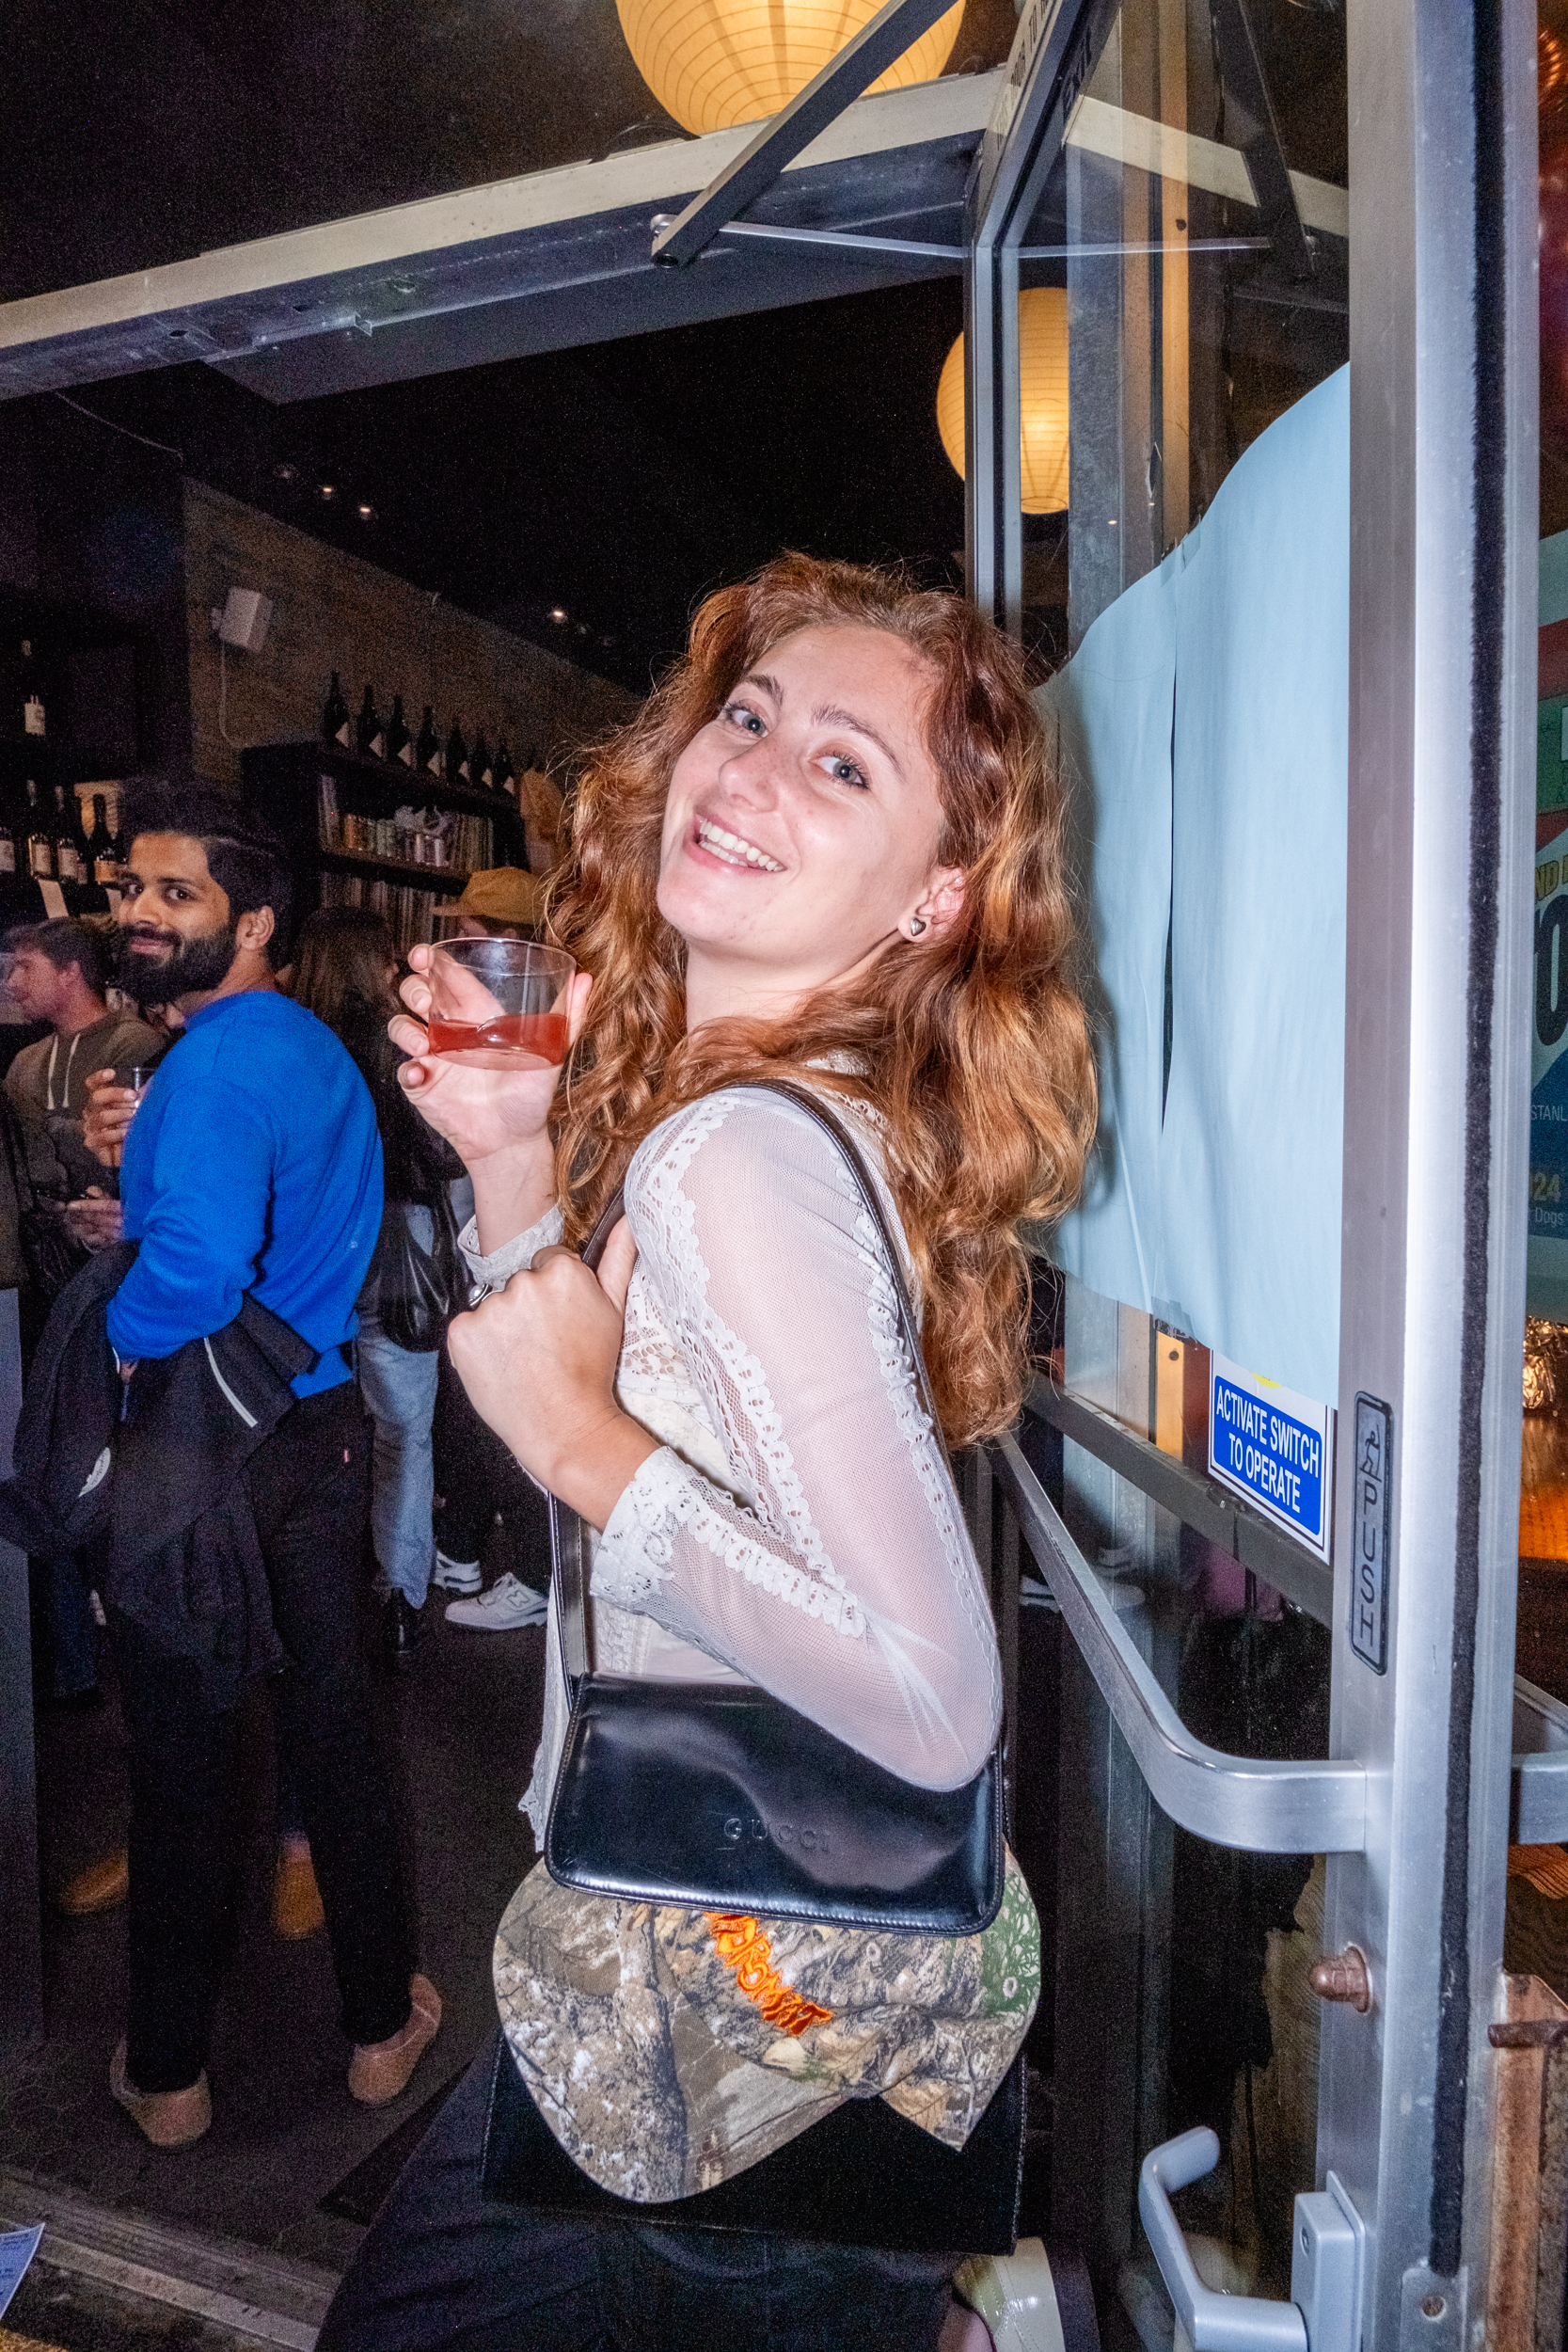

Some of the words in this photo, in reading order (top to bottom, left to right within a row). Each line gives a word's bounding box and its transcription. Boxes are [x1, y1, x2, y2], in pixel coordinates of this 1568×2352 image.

[1535, 1207, 1565, 1228] Dogs
[1216, 1385, 1267, 1445] ACTIVATE
[1270, 1415, 1319, 1478] SWITCH
[1228, 1432, 1243, 1470] TO
[1245, 1444, 1301, 1513] OPERATE
[1360, 1480, 1378, 1647] PUSH
